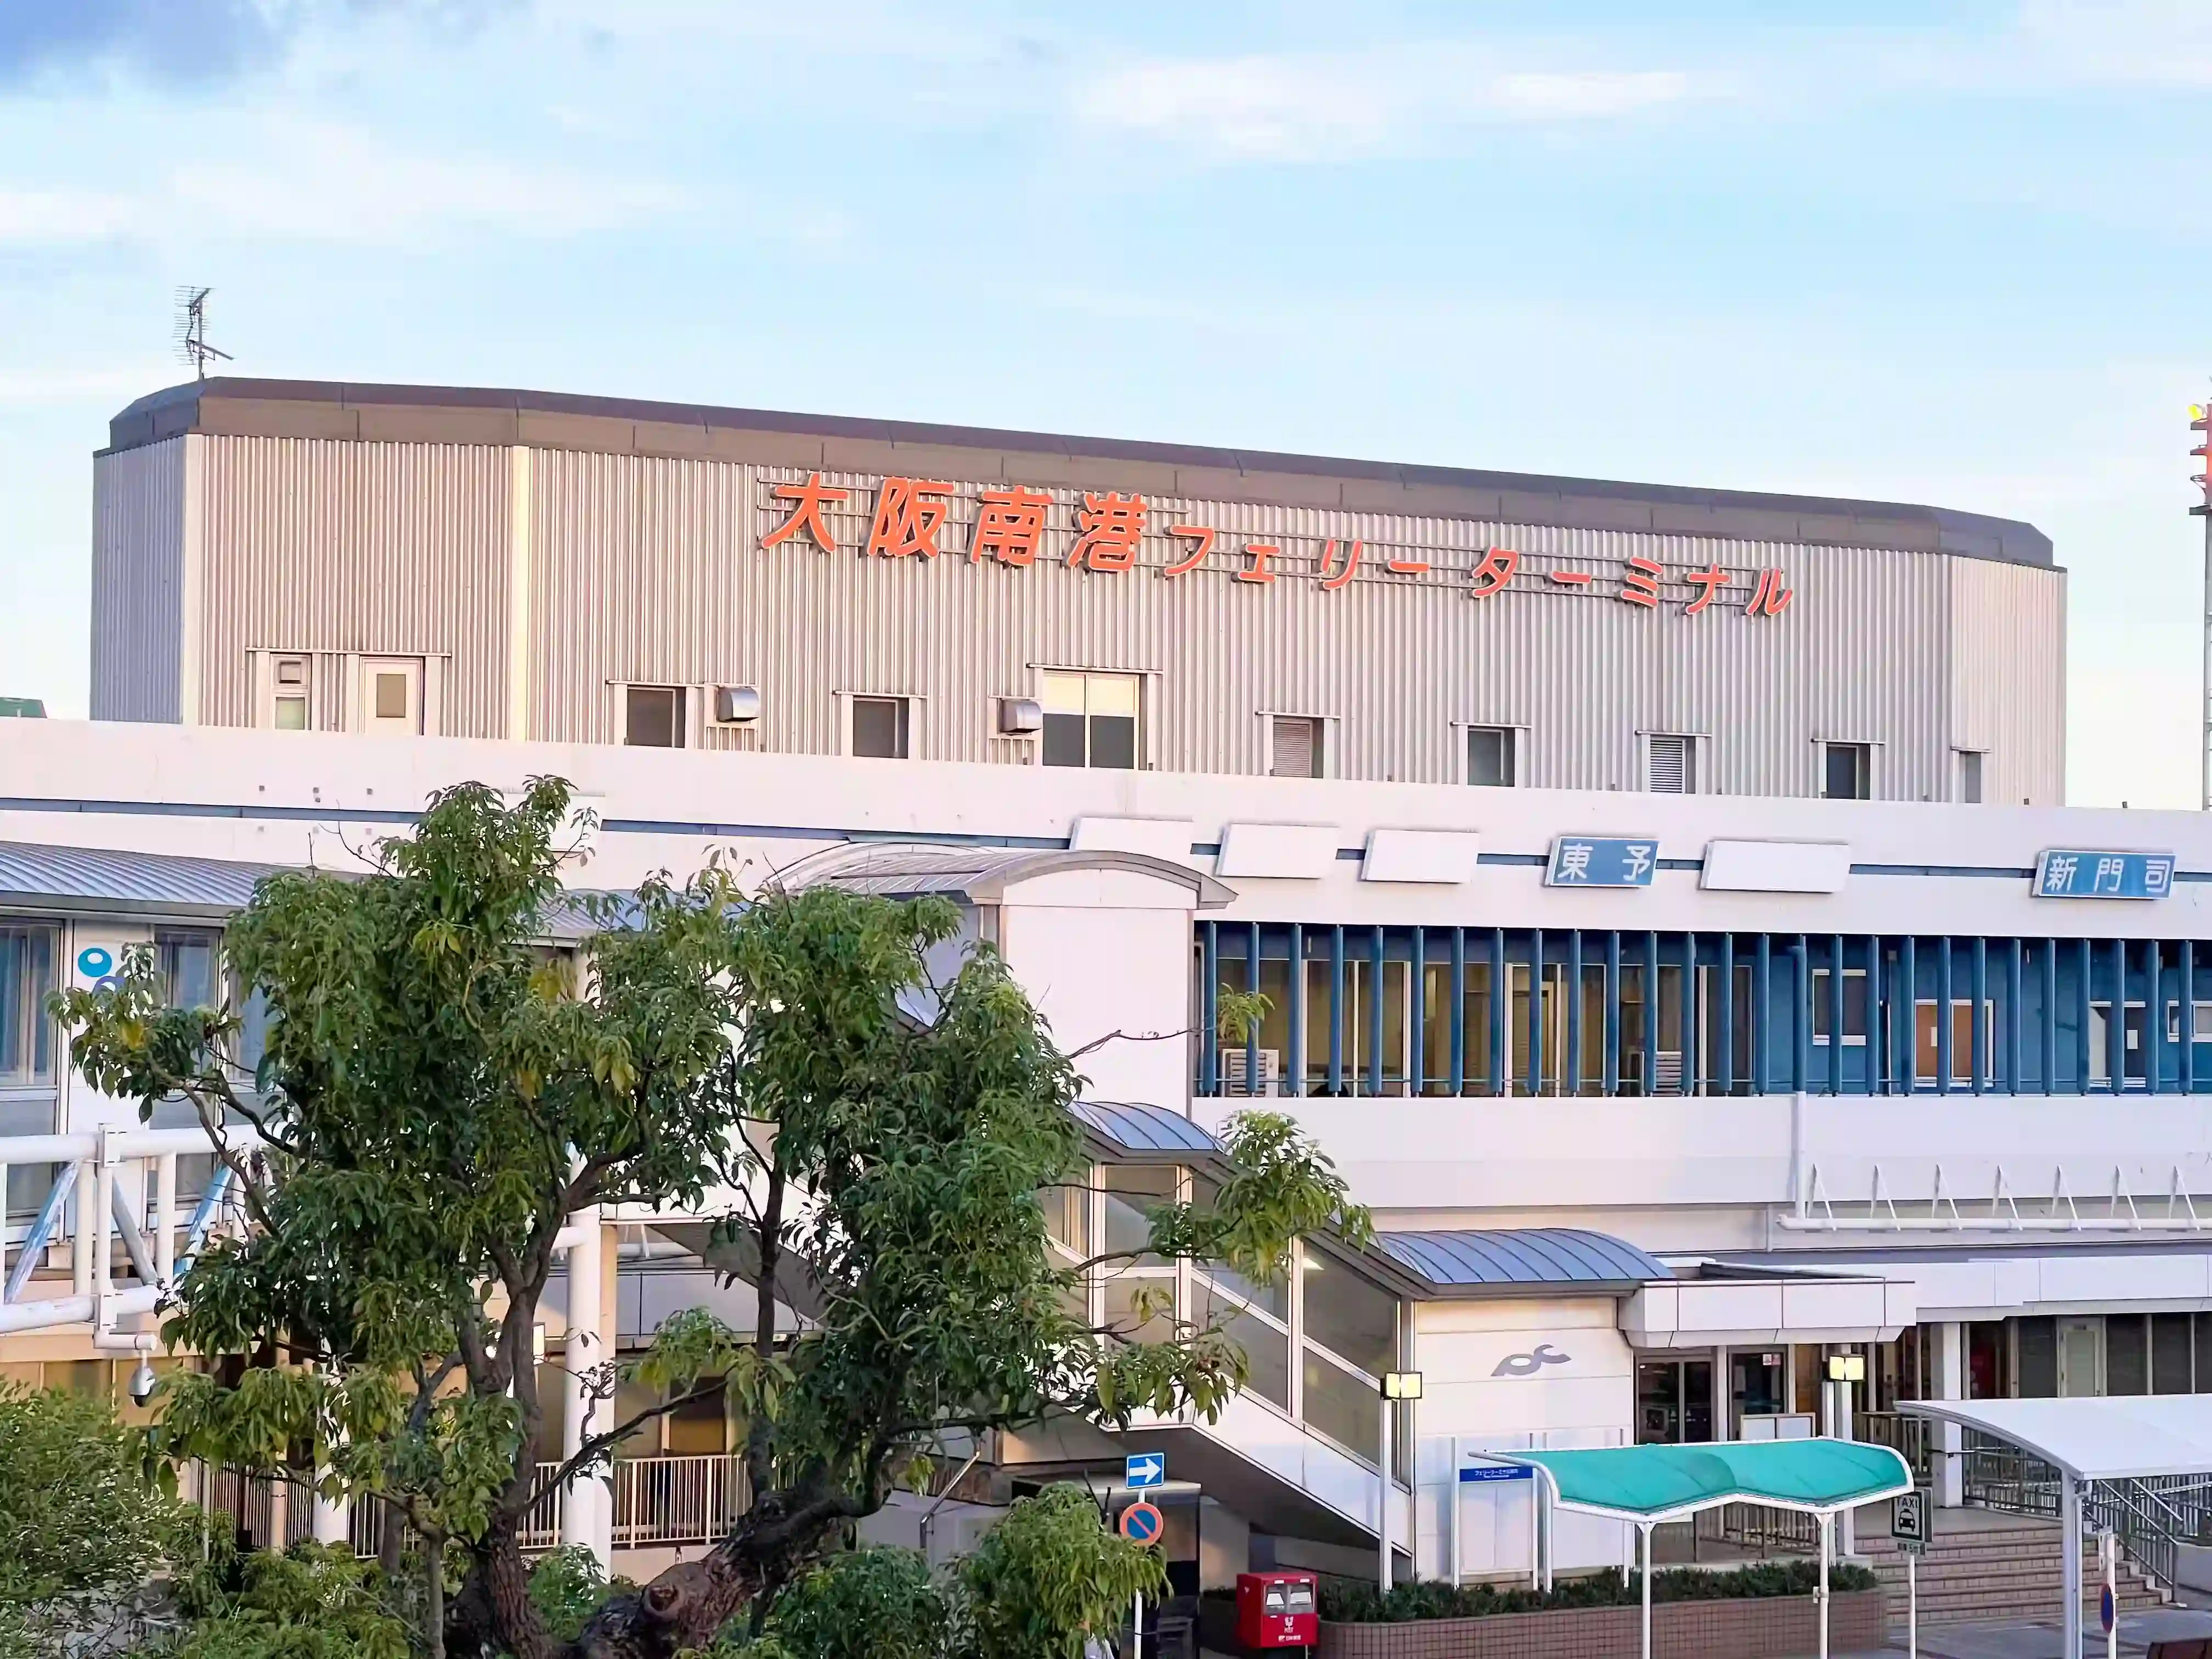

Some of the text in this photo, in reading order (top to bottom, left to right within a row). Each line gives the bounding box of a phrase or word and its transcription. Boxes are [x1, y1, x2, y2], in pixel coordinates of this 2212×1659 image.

[761, 471, 1793, 616] 大阪南港フェリーターミナル
[1558, 843, 1651, 881] 東予
[2046, 855, 2170, 893] 新門司
